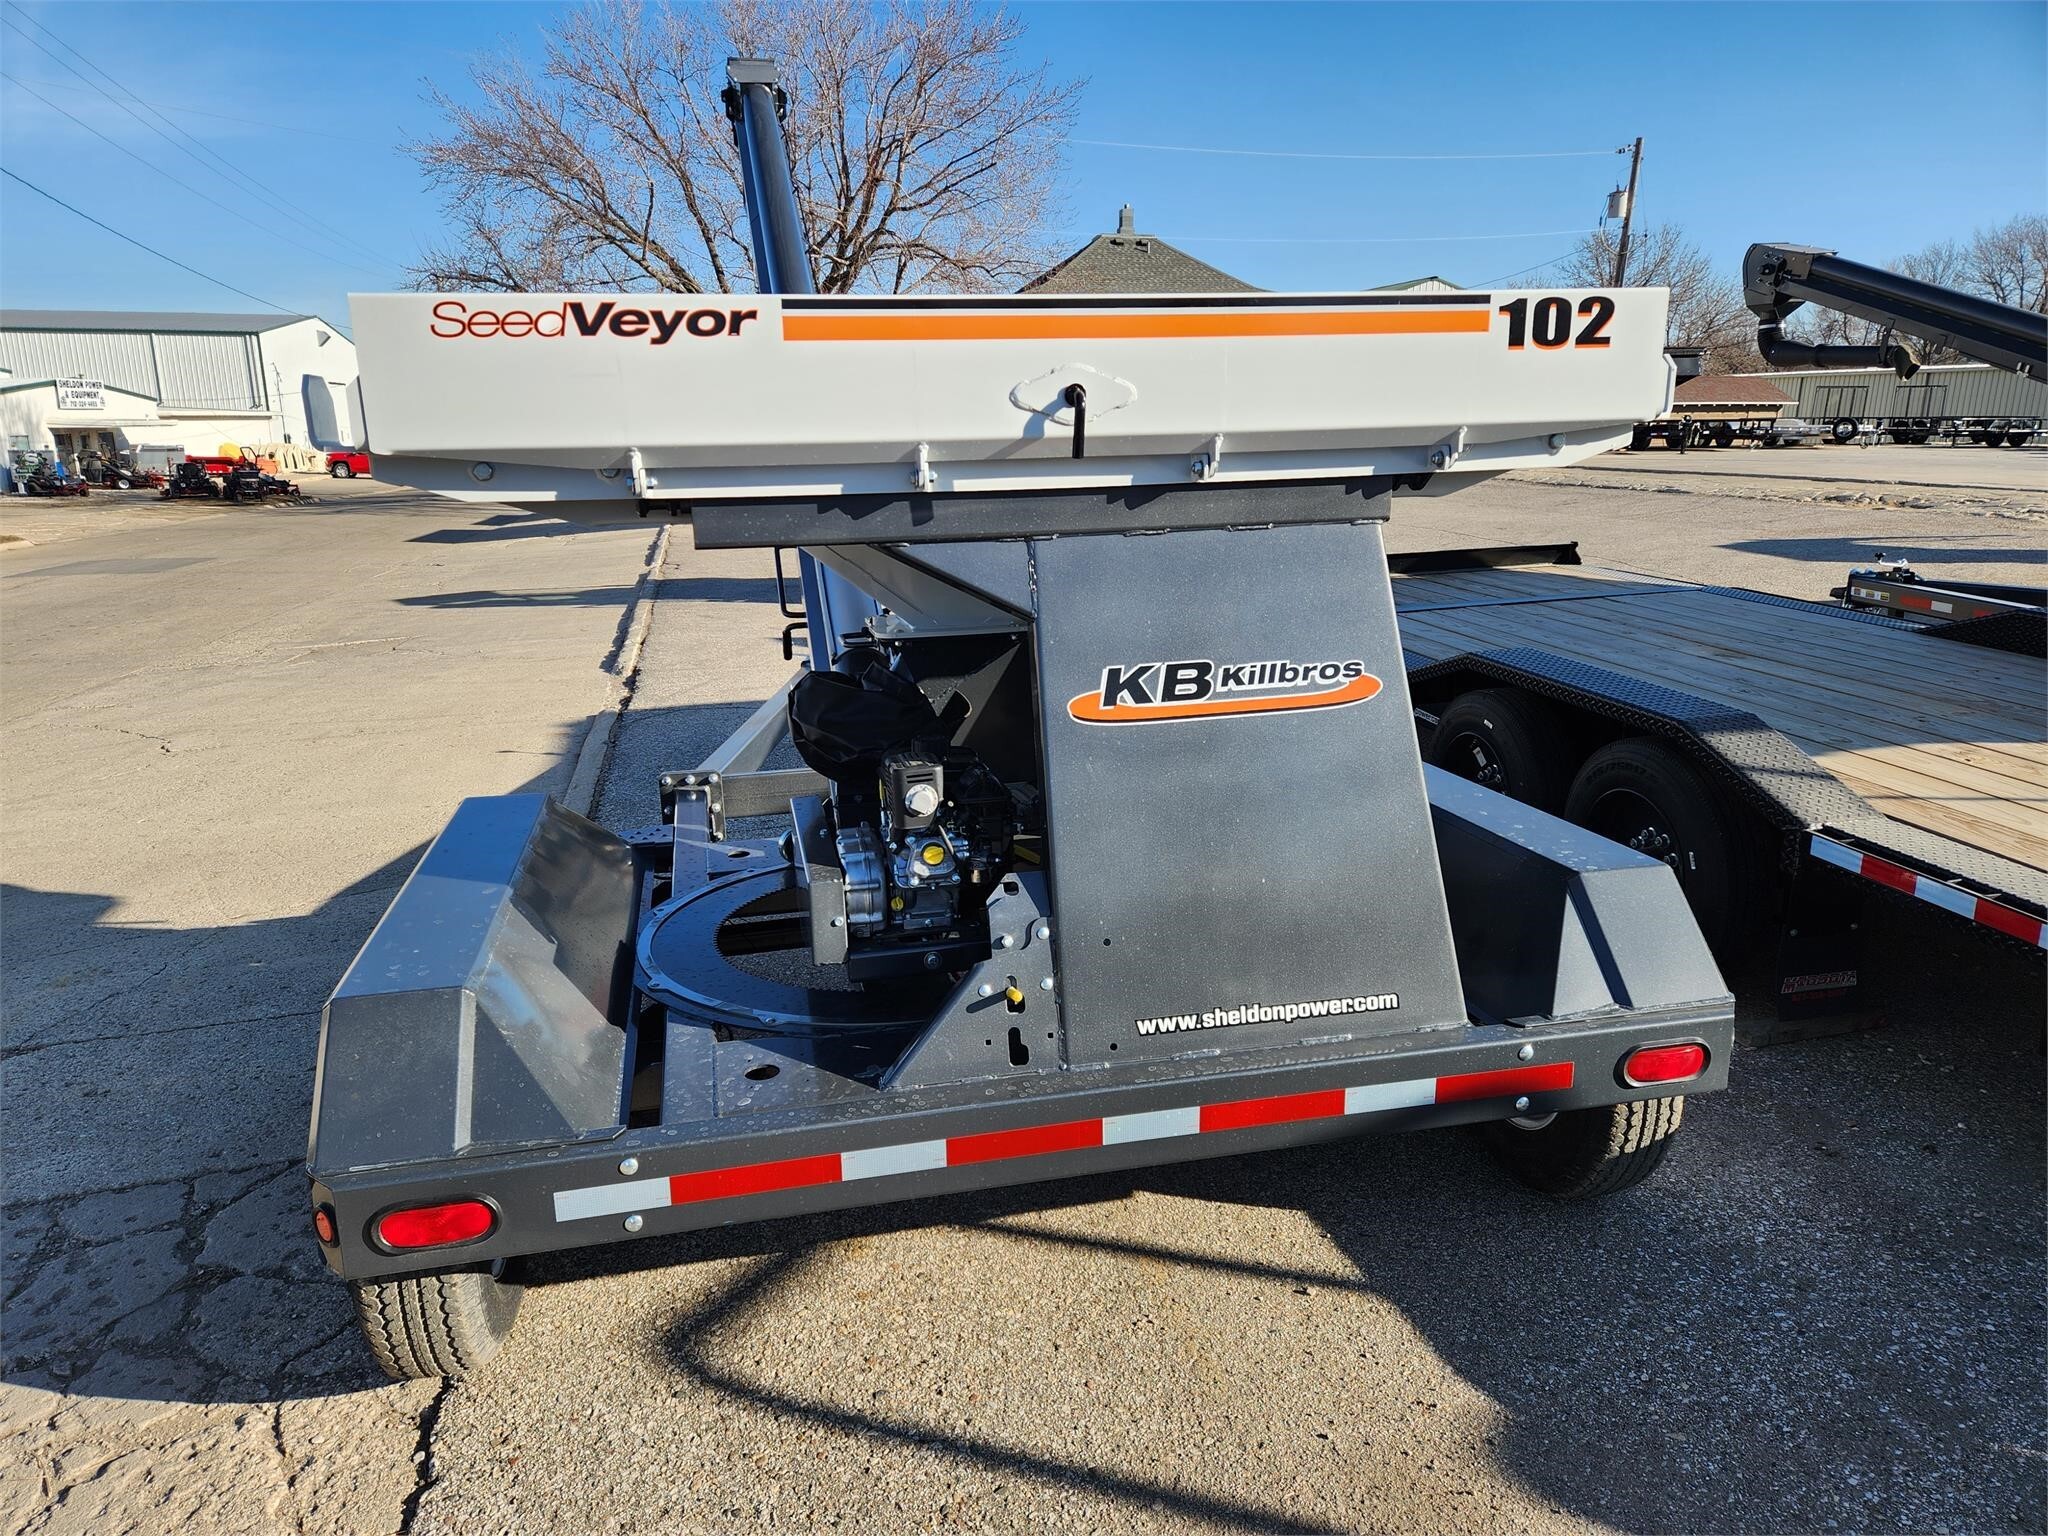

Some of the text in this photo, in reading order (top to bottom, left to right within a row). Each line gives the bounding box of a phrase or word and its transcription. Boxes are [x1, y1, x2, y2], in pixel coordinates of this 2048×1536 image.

[430, 301, 758, 345] SeedVeyor
[1498, 296, 1616, 350] 102
[58, 379, 103, 390] SHELDON POWER
[65, 390, 99, 399] & EQUIPMENT
[1102, 660, 1364, 707] KB Killbros
[1137, 993, 1399, 1036] www.sheldonpower.com
